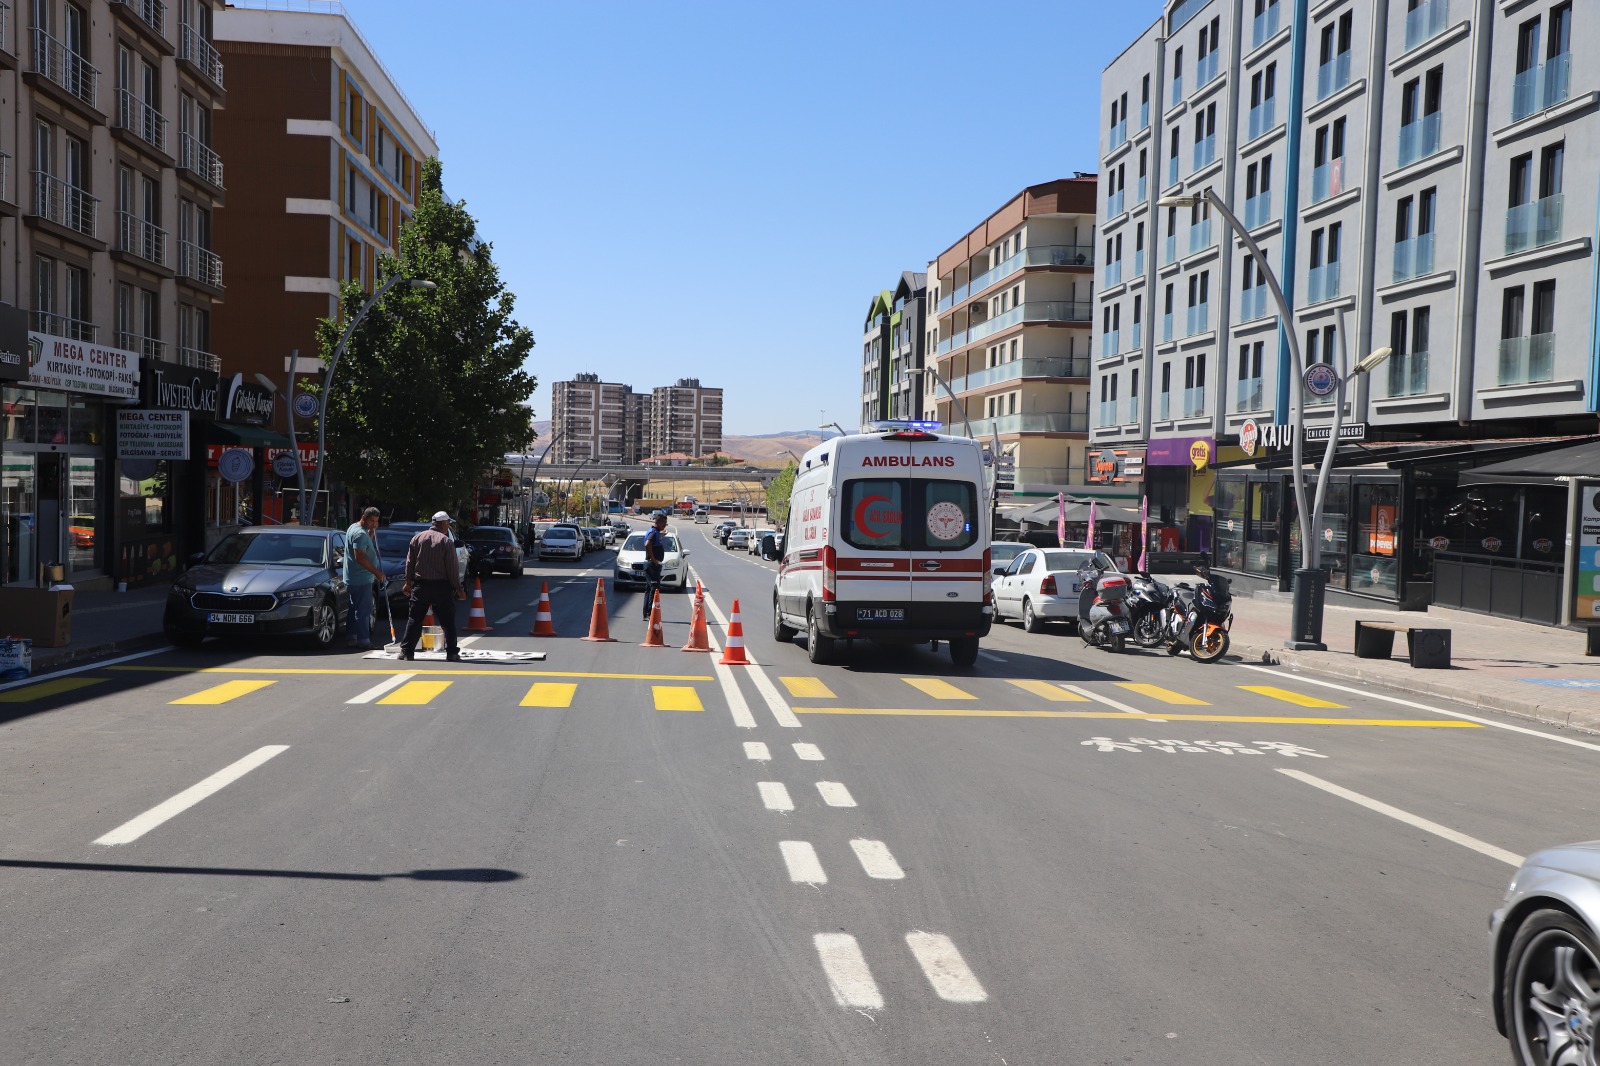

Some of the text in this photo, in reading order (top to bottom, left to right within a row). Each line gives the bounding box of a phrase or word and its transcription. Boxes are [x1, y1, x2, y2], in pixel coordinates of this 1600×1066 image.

[54, 341, 127, 369] MEGA CENTER
[47, 360, 132, 384] KIRTASİYE FOTOKOPİ FAKS
[119, 412, 182, 422] MEGA CENTER
[1339, 427, 1363, 436] URGERS
[1260, 424, 1292, 451] KAJU
[118, 440, 129, 448] CEP
[130, 440, 155, 448] TELEFONU
[120, 447, 182, 457] BİLGİSAYAR SERVİS
[1191, 445, 1206, 460] gratis
[861, 456, 955, 467] AMBULANS
[211, 613, 220, 622] 34
[239, 614, 253, 623] 666
[862, 609, 871, 618] 71
[890, 610, 903, 618] 028
[1149, 745, 1266, 756] yaya
